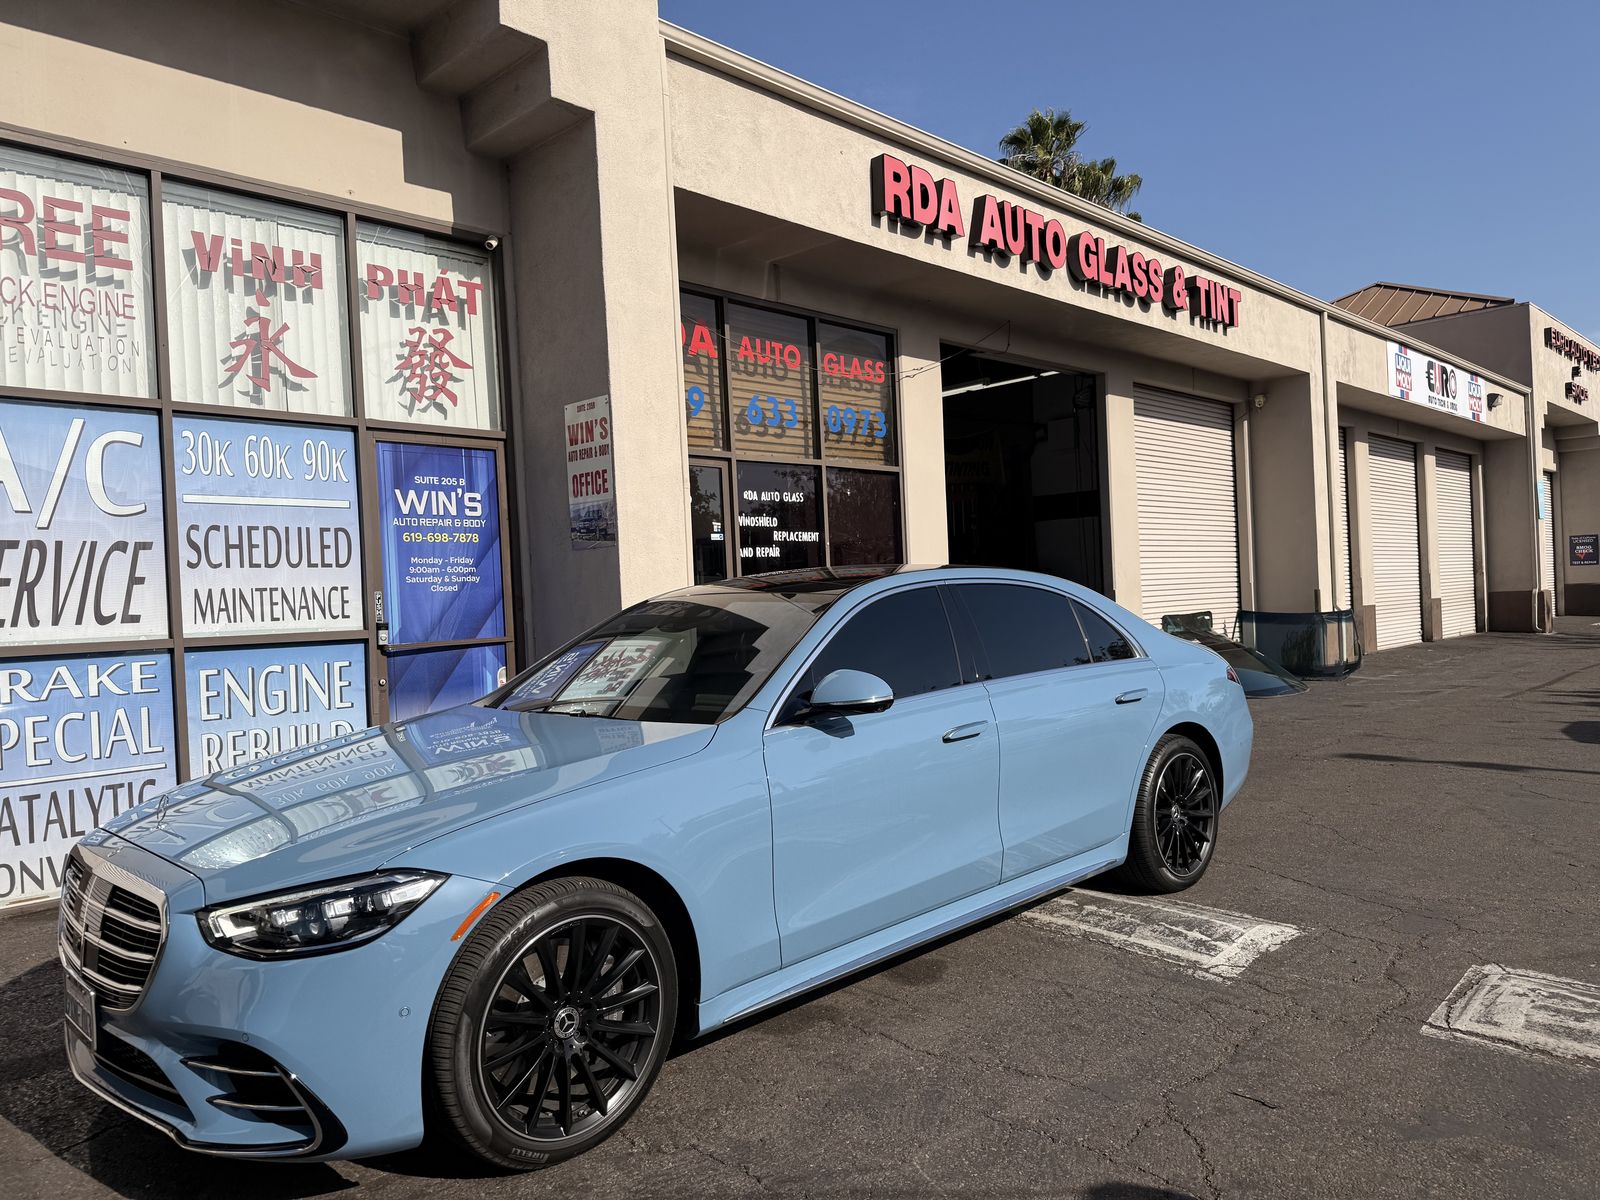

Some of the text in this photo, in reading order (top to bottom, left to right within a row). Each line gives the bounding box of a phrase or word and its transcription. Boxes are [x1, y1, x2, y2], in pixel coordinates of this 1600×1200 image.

[881, 153, 1242, 328] RDA AUTO GLASS & TINT
[43, 282, 136, 320] ENGINE
[17, 326, 141, 357] EVALUATION
[224, 288, 473, 408] 永 發
[738, 335, 801, 369] AUTO
[823, 352, 886, 383] GLASS
[747, 394, 799, 428] 633
[827, 404, 887, 438] 0973
[567, 416, 609, 447] WIN'S
[181, 429, 349, 483] 30K 60K 90K
[568, 449, 578, 463] AUTO
[579, 447, 593, 461] REPAIR
[598, 444, 609, 457] BODY
[414, 475, 466, 486] SUITE 205 B
[572, 468, 609, 498] OFFICE
[394, 488, 482, 517] WIN'S
[743, 490, 804, 503] RDA AUTO GLASS
[392, 517, 487, 528] AUTO REPAIR & BODY
[402, 532, 480, 543] 619-698-7878
[773, 530, 820, 542] REPLACEMENT
[186, 523, 353, 569] SCHEDULED
[410, 556, 443, 565] Monday
[450, 556, 474, 566] Friday
[405, 575, 481, 584] Saturday & Sunday
[409, 566, 440, 574] 9:00am
[446, 566, 477, 575] 6:00pm
[430, 584, 459, 592] Closed
[194, 586, 351, 625] MAINTENANCE
[0, 660, 159, 704] RAKE
[199, 660, 354, 721] ENGINE
